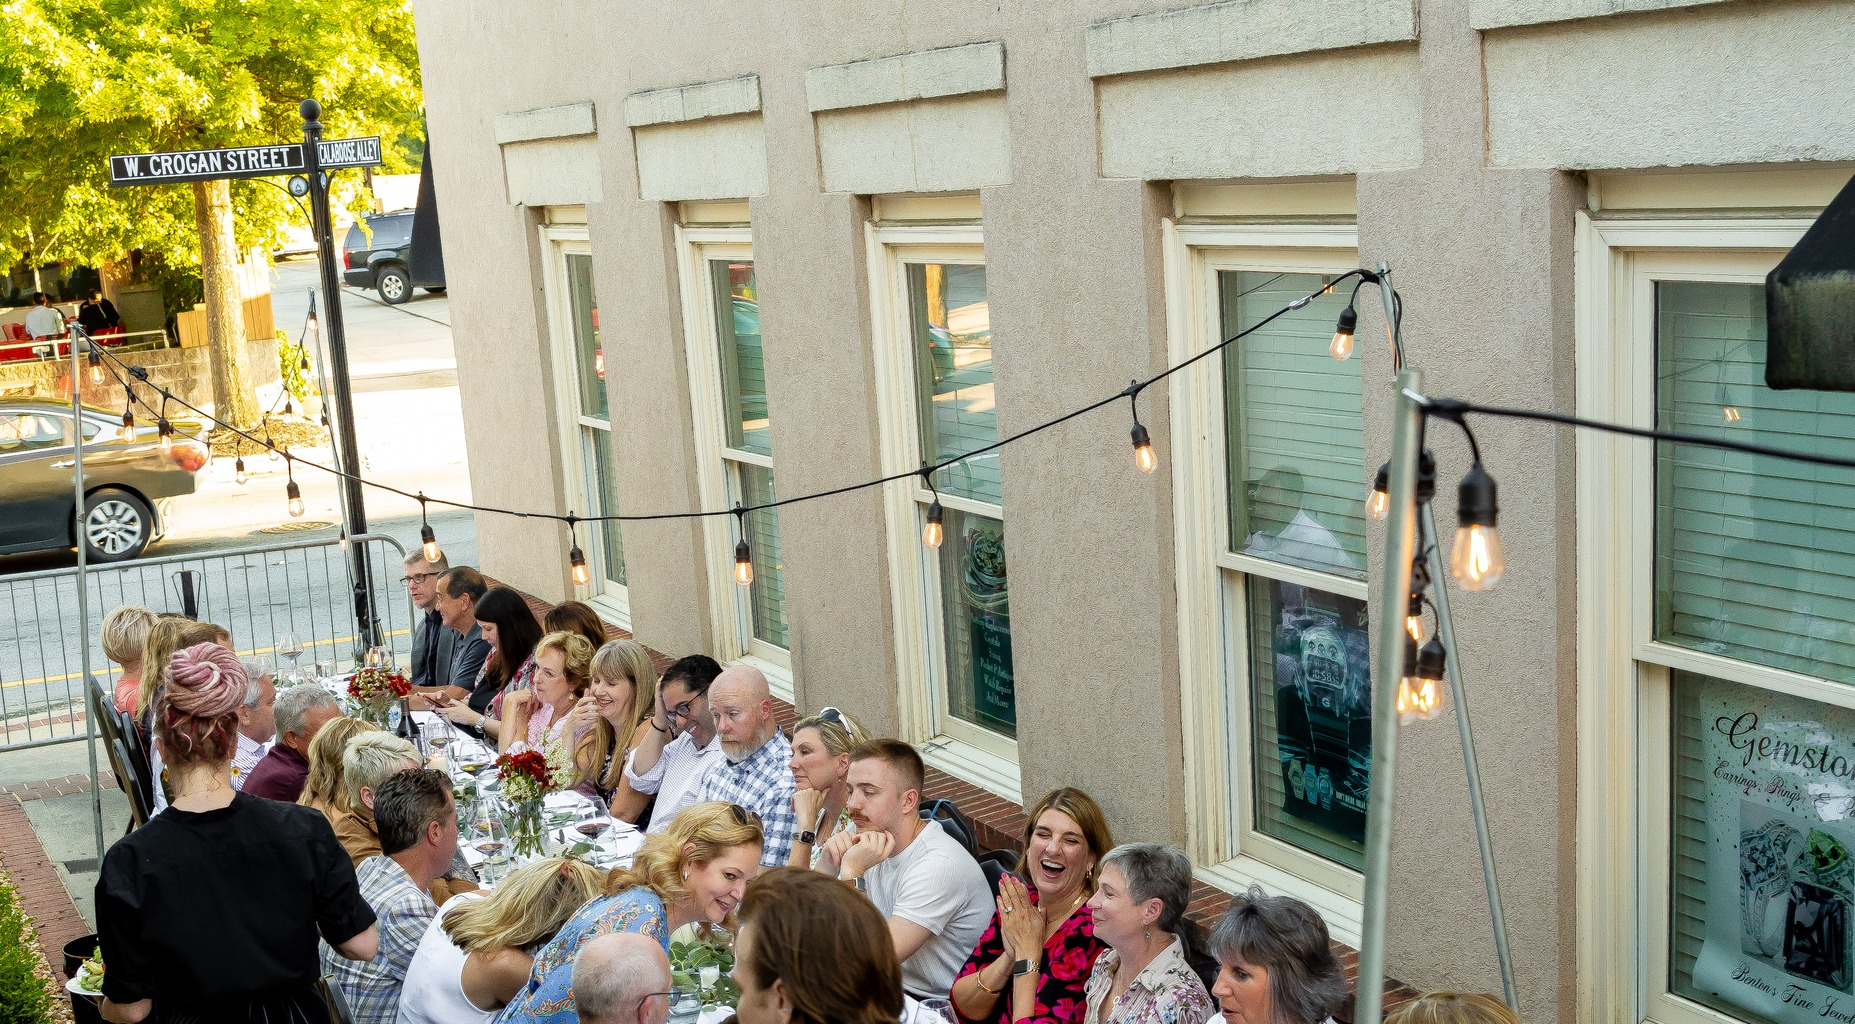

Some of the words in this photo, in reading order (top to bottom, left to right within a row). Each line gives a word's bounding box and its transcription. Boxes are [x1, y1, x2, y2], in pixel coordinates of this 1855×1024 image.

[124, 157, 144, 178] W.
[149, 150, 222, 176] CROGAN
[226, 147, 290, 171] STREET
[320, 142, 356, 164] CALABOOSE
[357, 139, 379, 161] ALLEY
[1731, 961, 1779, 997] Benton's
[1781, 982, 1814, 1010] Fine
